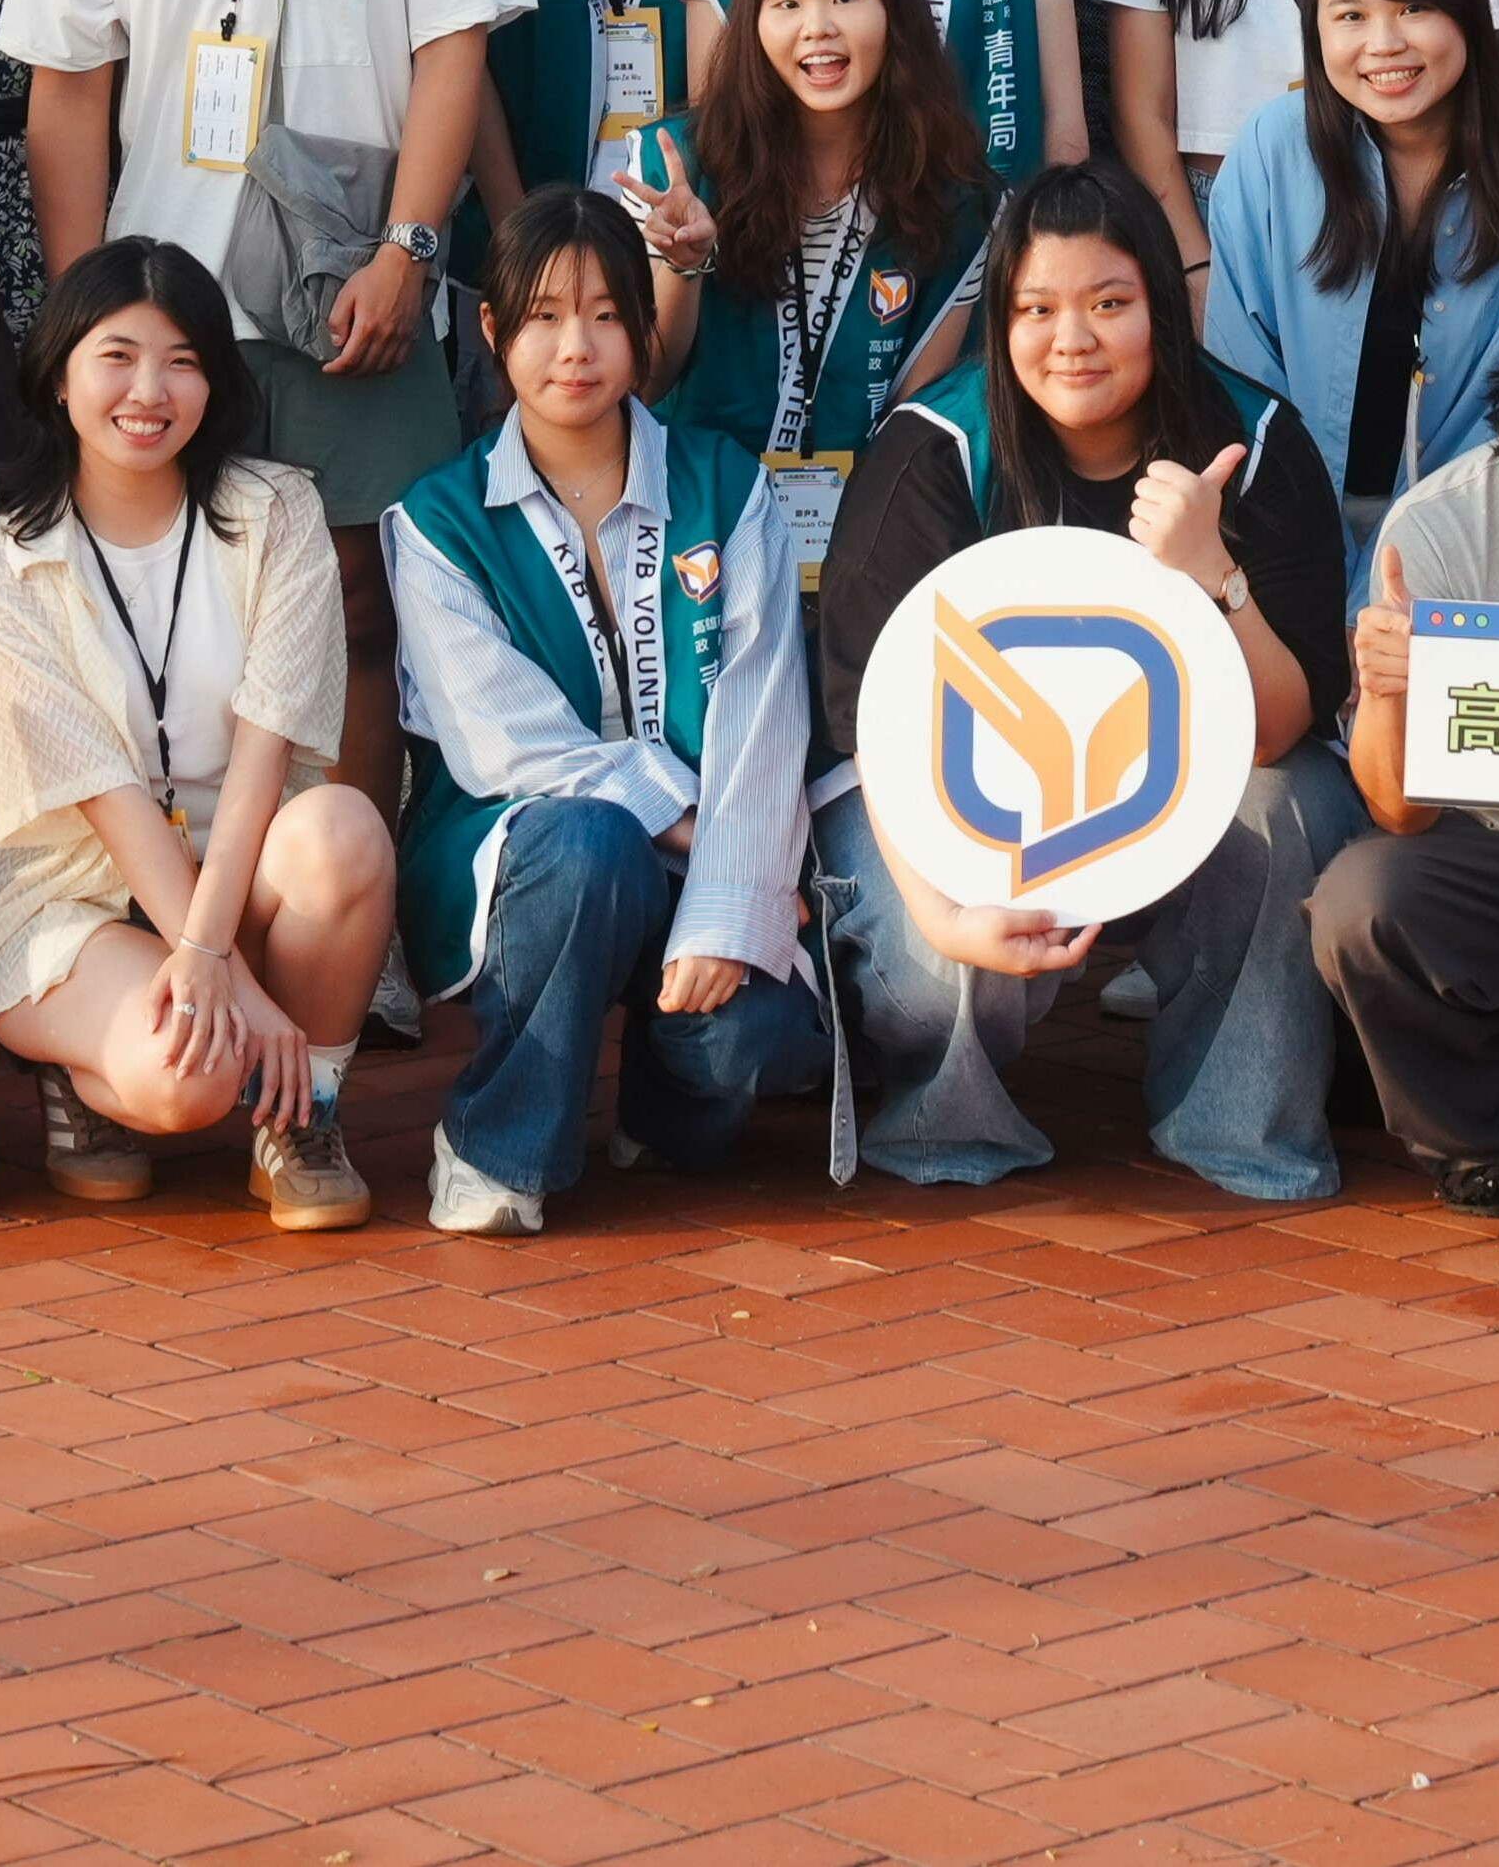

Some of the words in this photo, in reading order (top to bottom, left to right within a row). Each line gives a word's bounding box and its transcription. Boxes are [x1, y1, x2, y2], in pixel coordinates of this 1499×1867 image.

[983, 28, 1018, 153] 青年局
[553, 542, 589, 599] KYB
[635, 523, 660, 580] KYB
